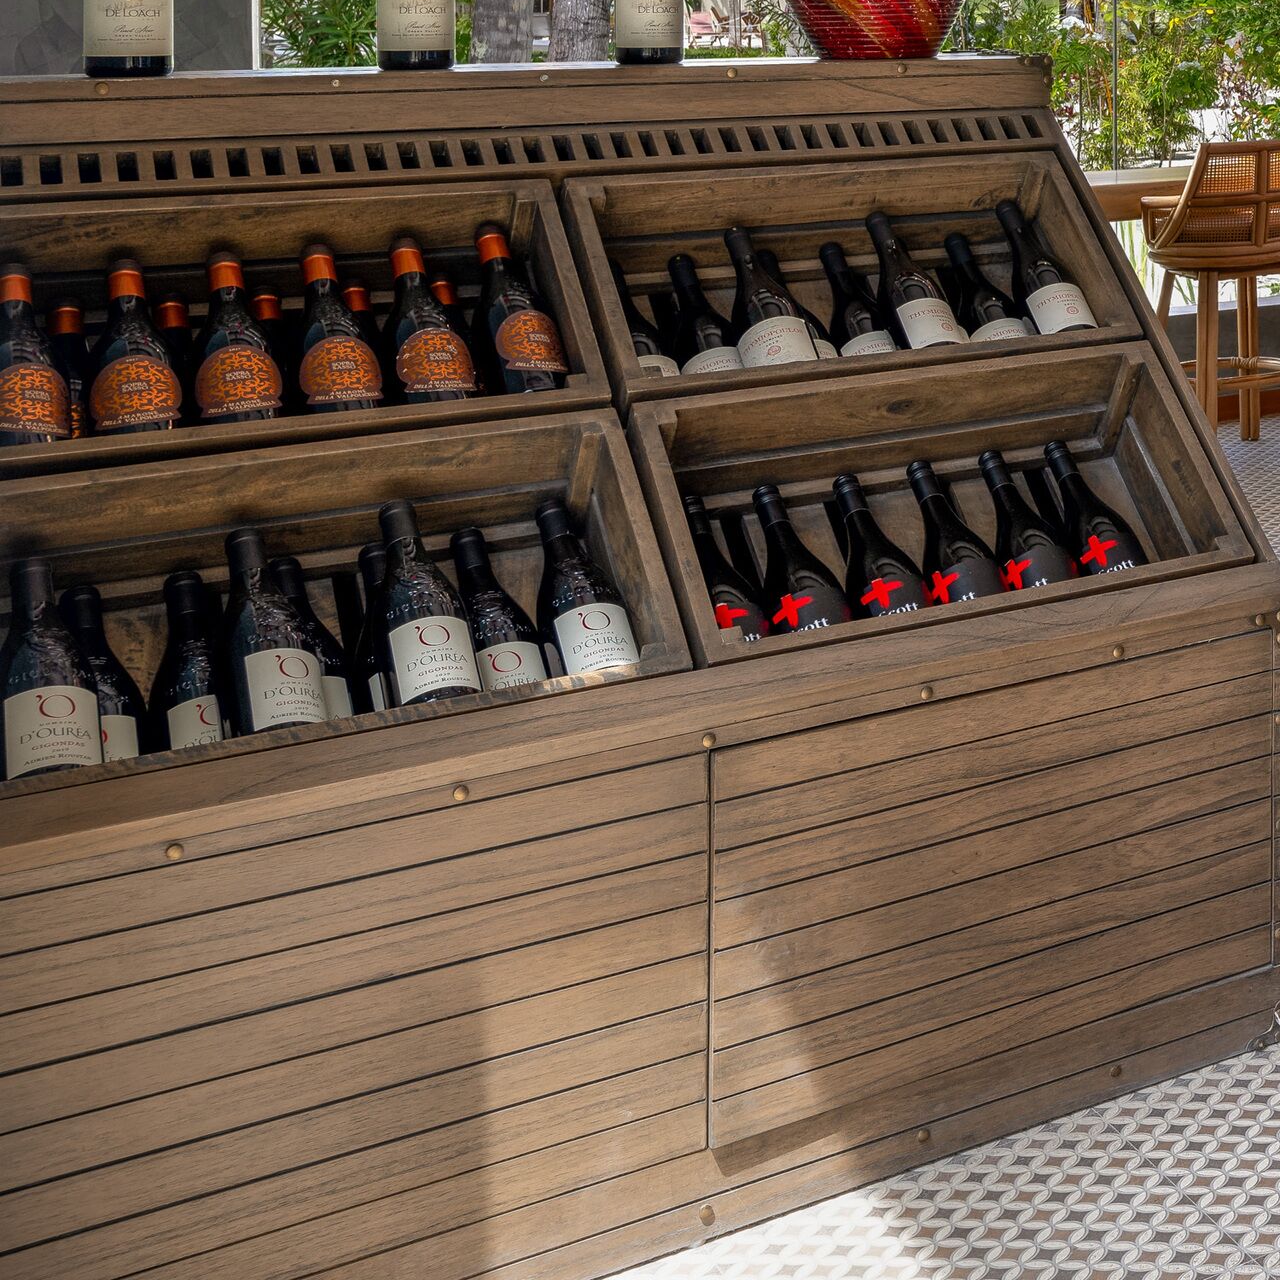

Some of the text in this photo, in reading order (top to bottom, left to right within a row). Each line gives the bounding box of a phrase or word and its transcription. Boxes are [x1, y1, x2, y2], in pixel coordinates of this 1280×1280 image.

[123, 8, 160, 17] LOACH
[414, 6, 447, 14] LOACH
[652, 5, 679, 14] LOACH
[583, 647, 625, 658] GIGONDAS
[418, 665, 464, 677] GIGONDAS
[276, 699, 321, 709] GIGONDAS
[32, 740, 86, 751] GIGONDAS
